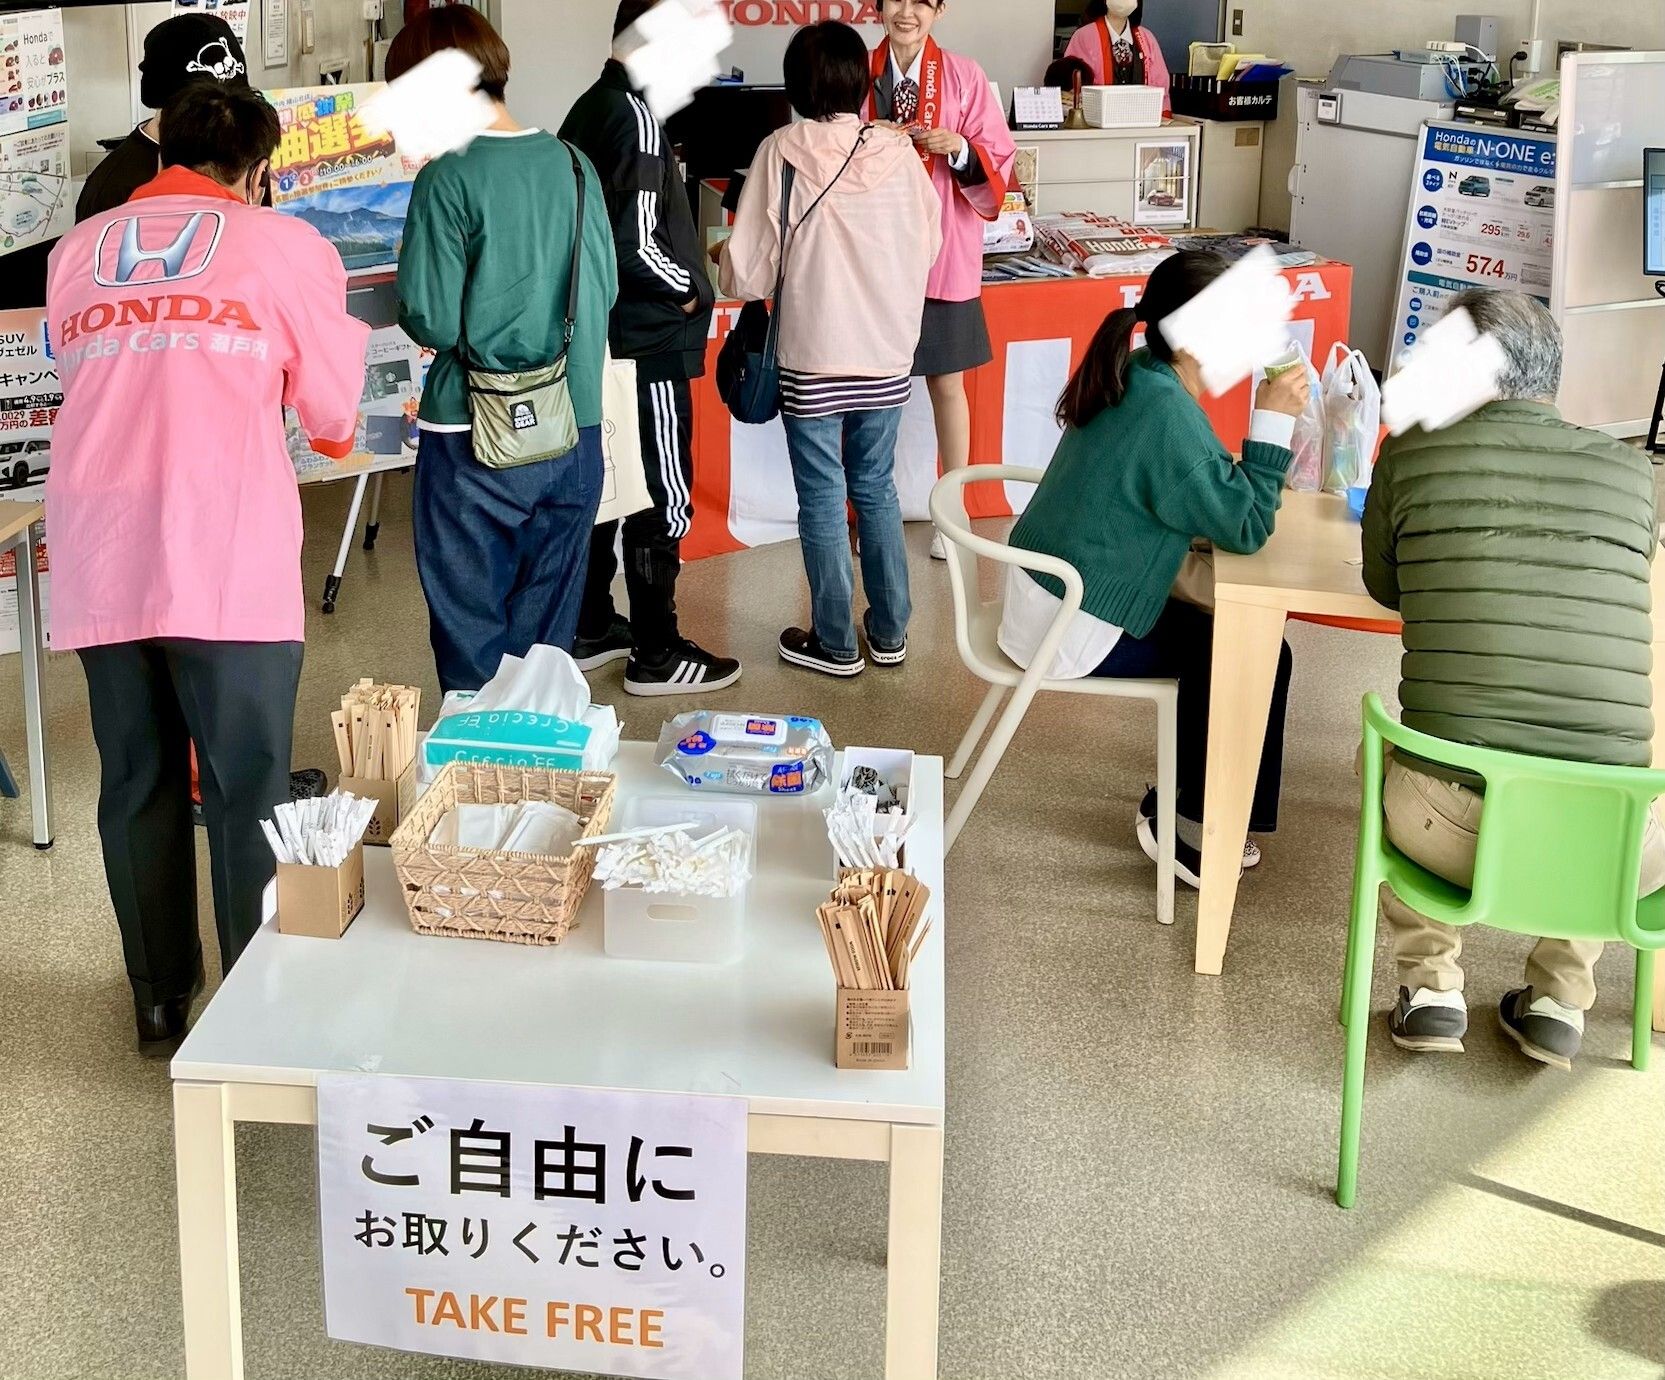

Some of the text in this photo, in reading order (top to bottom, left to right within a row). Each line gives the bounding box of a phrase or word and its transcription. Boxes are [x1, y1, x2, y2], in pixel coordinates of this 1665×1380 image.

[723, 0, 884, 26] ONDA
[924, 60, 938, 130] Honda Car
[1228, 95, 1272, 106] お客様カルテ
[1434, 131, 1477, 147] Hondaの
[1476, 138, 1536, 163] N-ONE
[1481, 223, 1501, 236] 295
[1085, 237, 1148, 252] Honda
[1466, 254, 1505, 278] 57.4
[1504, 273, 1518, 281] 万円
[61, 295, 262, 347] HONDA
[128, 329, 200, 353] Cars
[208, 332, 270, 362] 瀬戸内
[487, 712, 570, 733] Crecia
[361, 1114, 697, 1205] ご自由に
[353, 1209, 726, 1279] お取りください。
[404, 1287, 665, 1348] TAKE FREE
